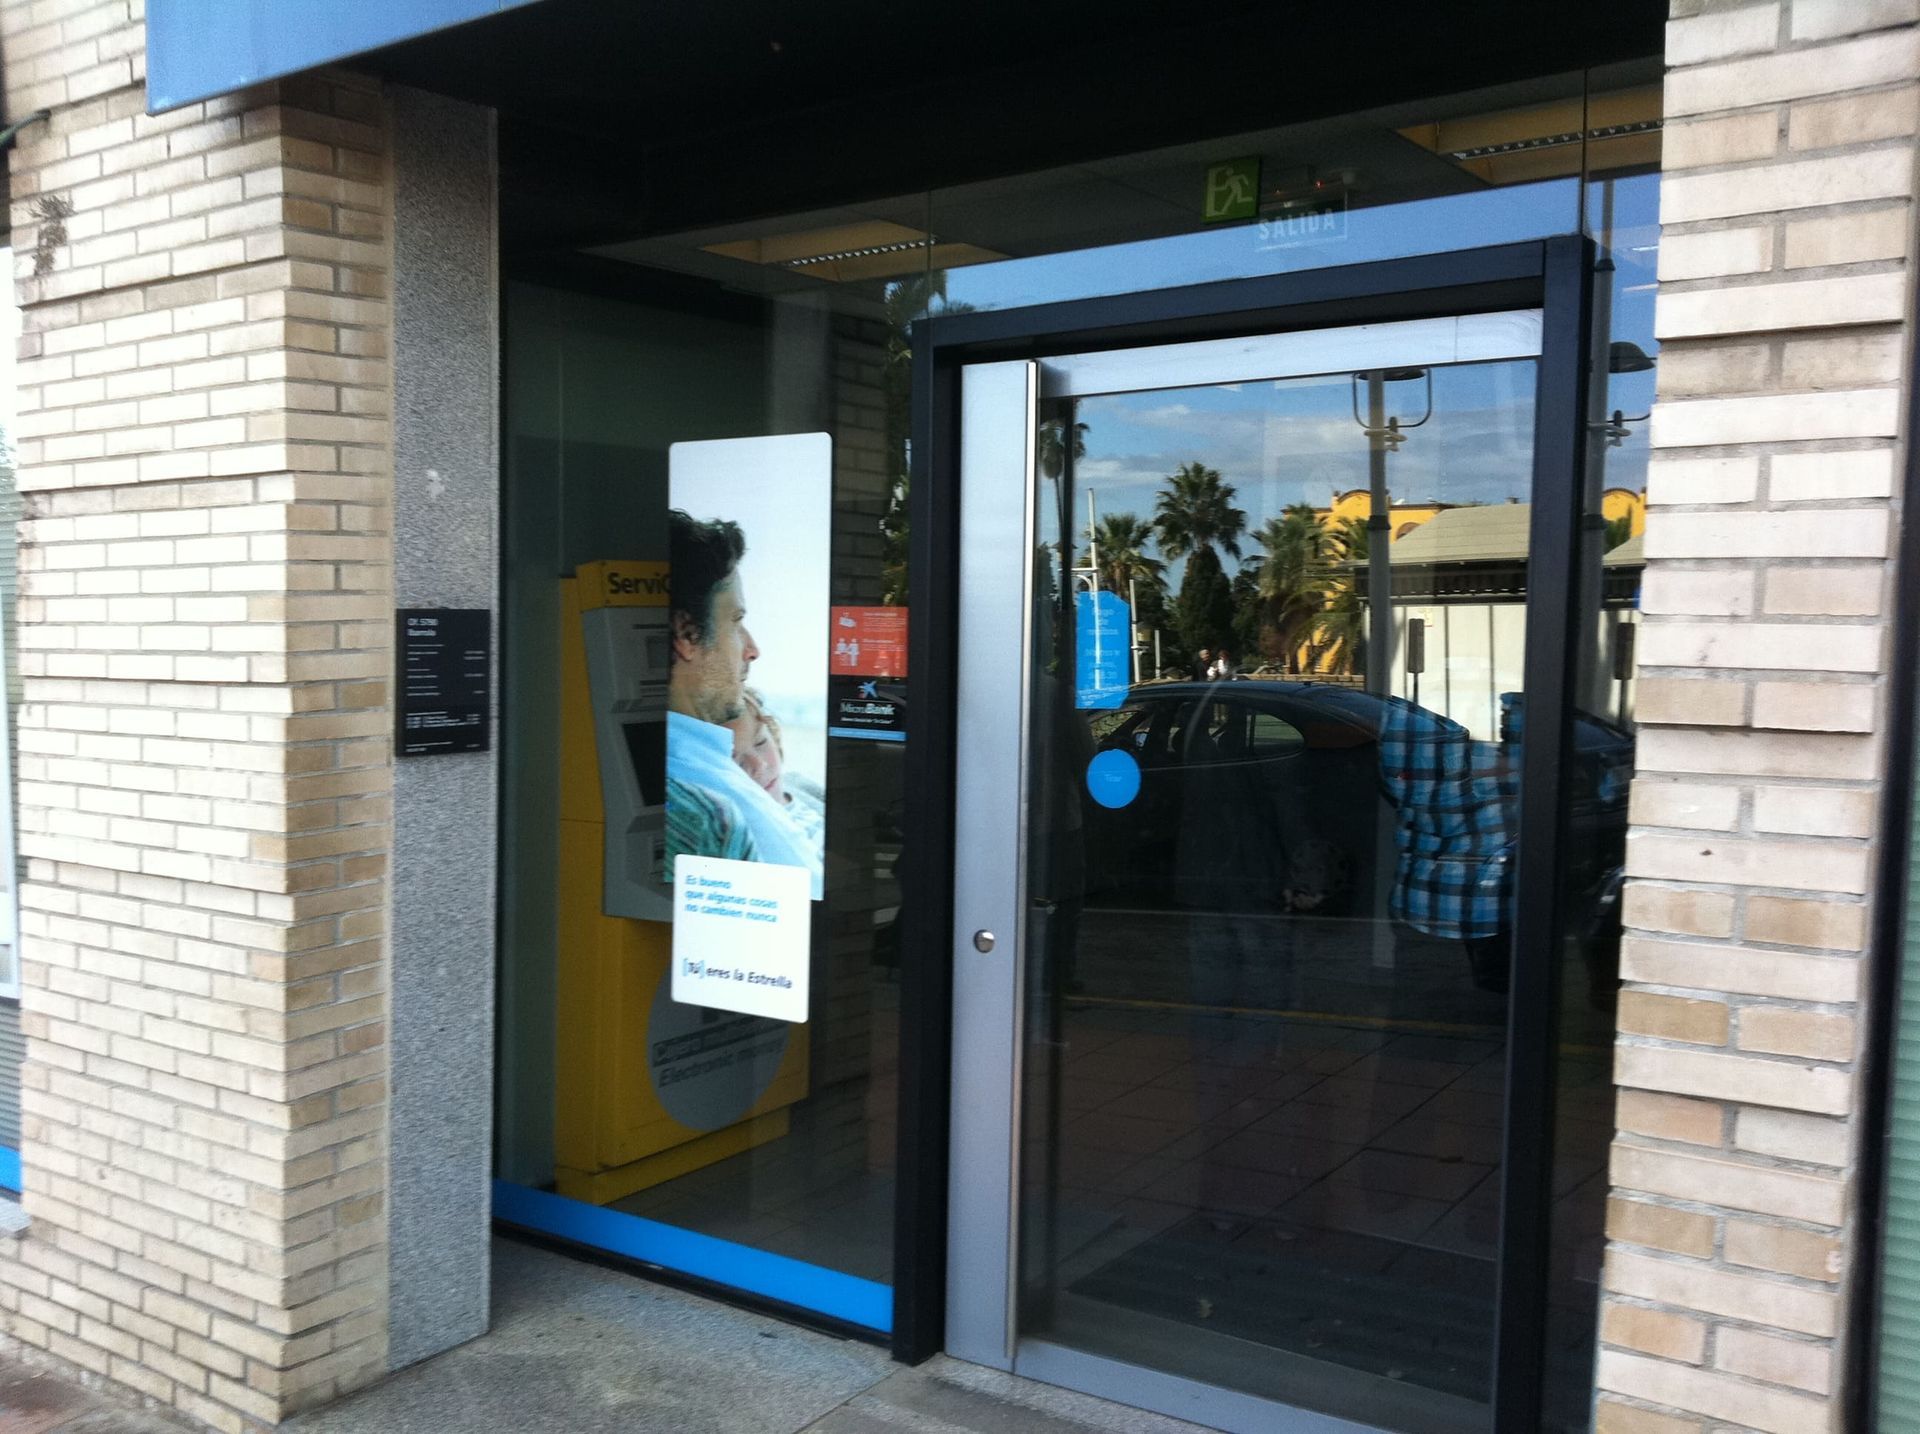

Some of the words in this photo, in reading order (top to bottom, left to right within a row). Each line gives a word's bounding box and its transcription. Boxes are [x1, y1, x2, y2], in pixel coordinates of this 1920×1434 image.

[1258, 208, 1336, 241] SALIDA
[685, 874, 698, 886] Es
[699, 876, 732, 890] bueno
[684, 890, 705, 901] que
[707, 891, 747, 905] algunas
[749, 898, 778, 909] cosas
[684, 903, 699, 913] no
[701, 905, 743, 918] cambien
[746, 911, 777, 923] nunca
[706, 967, 731, 980] eres
[733, 967, 745, 981] la
[747, 971, 793, 989] Estrella
